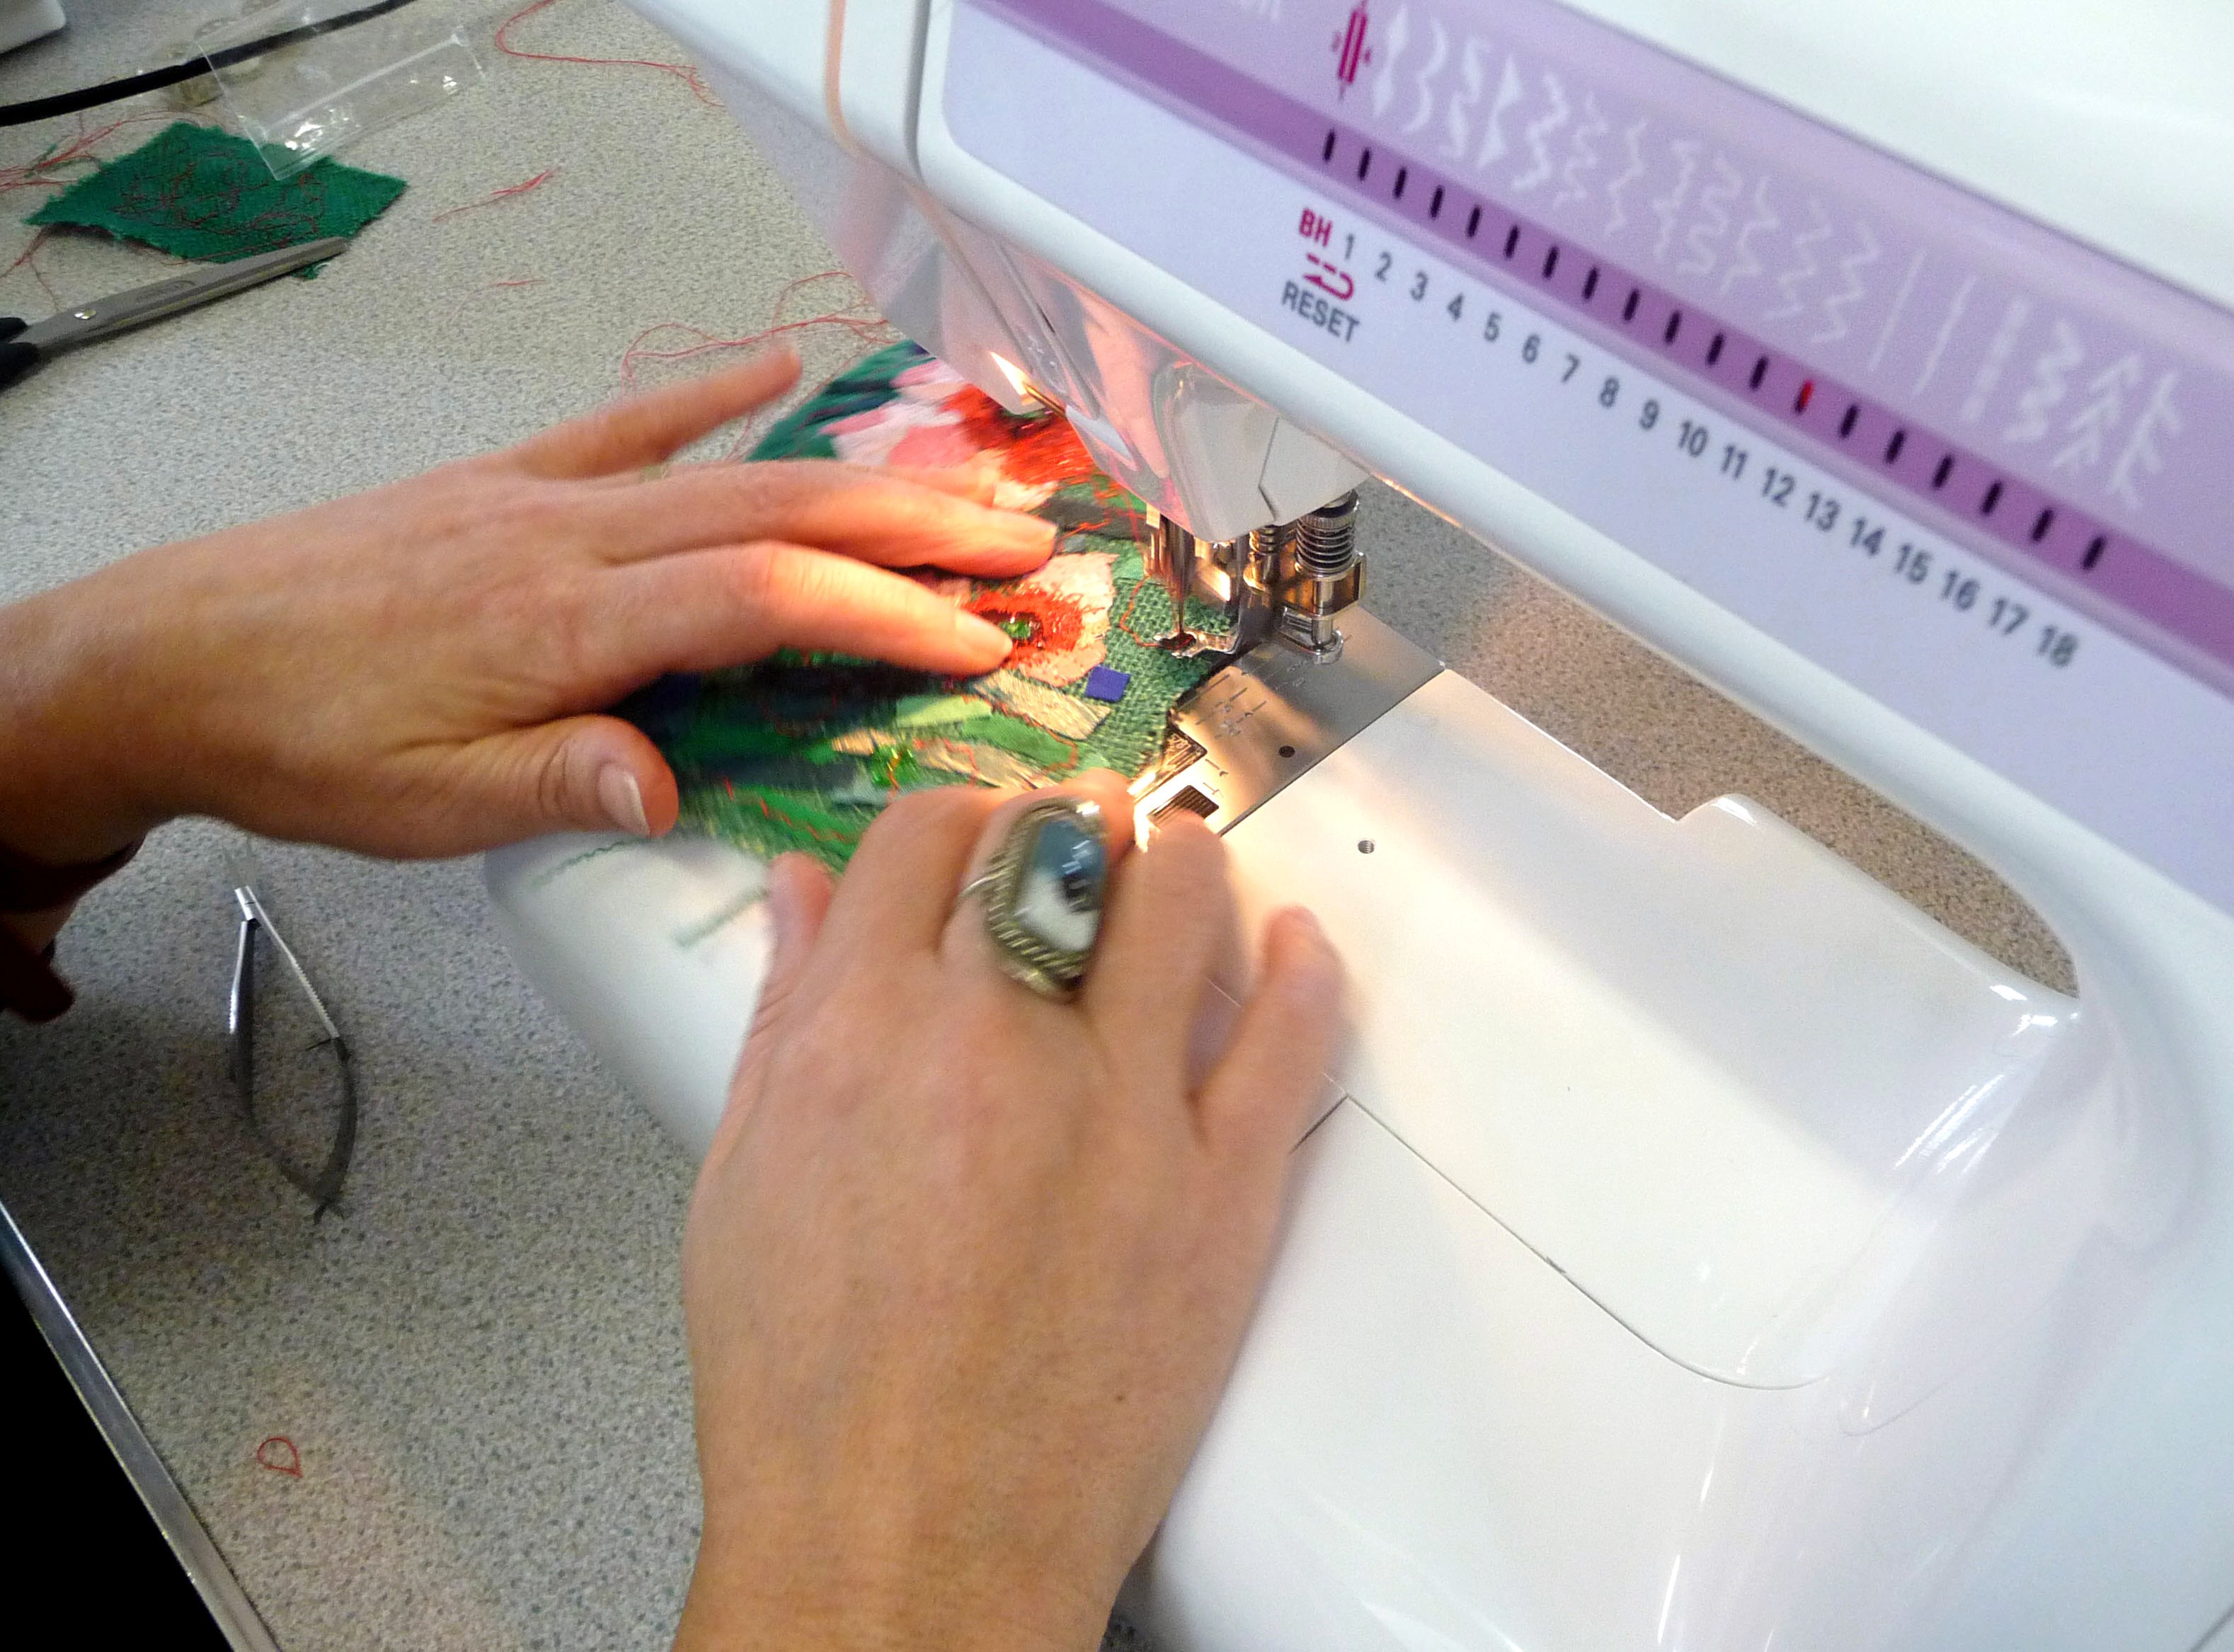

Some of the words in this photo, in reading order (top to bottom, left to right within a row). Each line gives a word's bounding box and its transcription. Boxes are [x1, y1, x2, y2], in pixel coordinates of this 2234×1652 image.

[1281, 280, 1361, 343] RESET
[1298, 207, 1333, 248] BH
[1344, 232, 1356, 261] 1
[1374, 251, 1392, 283] 2
[1410, 270, 1429, 302] 3
[1446, 292, 1465, 323] 4
[1484, 311, 1502, 343] 5
[1521, 333, 1542, 365] 6
[1562, 352, 1581, 384] 7
[1598, 376, 1620, 409] 8
[1639, 398, 1660, 431] 9
[1678, 420, 1708, 458] 10
[1721, 444, 1748, 481] 11
[1762, 467, 1796, 507] 12
[1804, 492, 1840, 532] 13
[1850, 517, 1885, 557] 14
[1894, 544, 1932, 585] 15
[1941, 570, 1980, 612] 16
[1988, 598, 2029, 635] 17
[2038, 625, 2079, 669] 18
